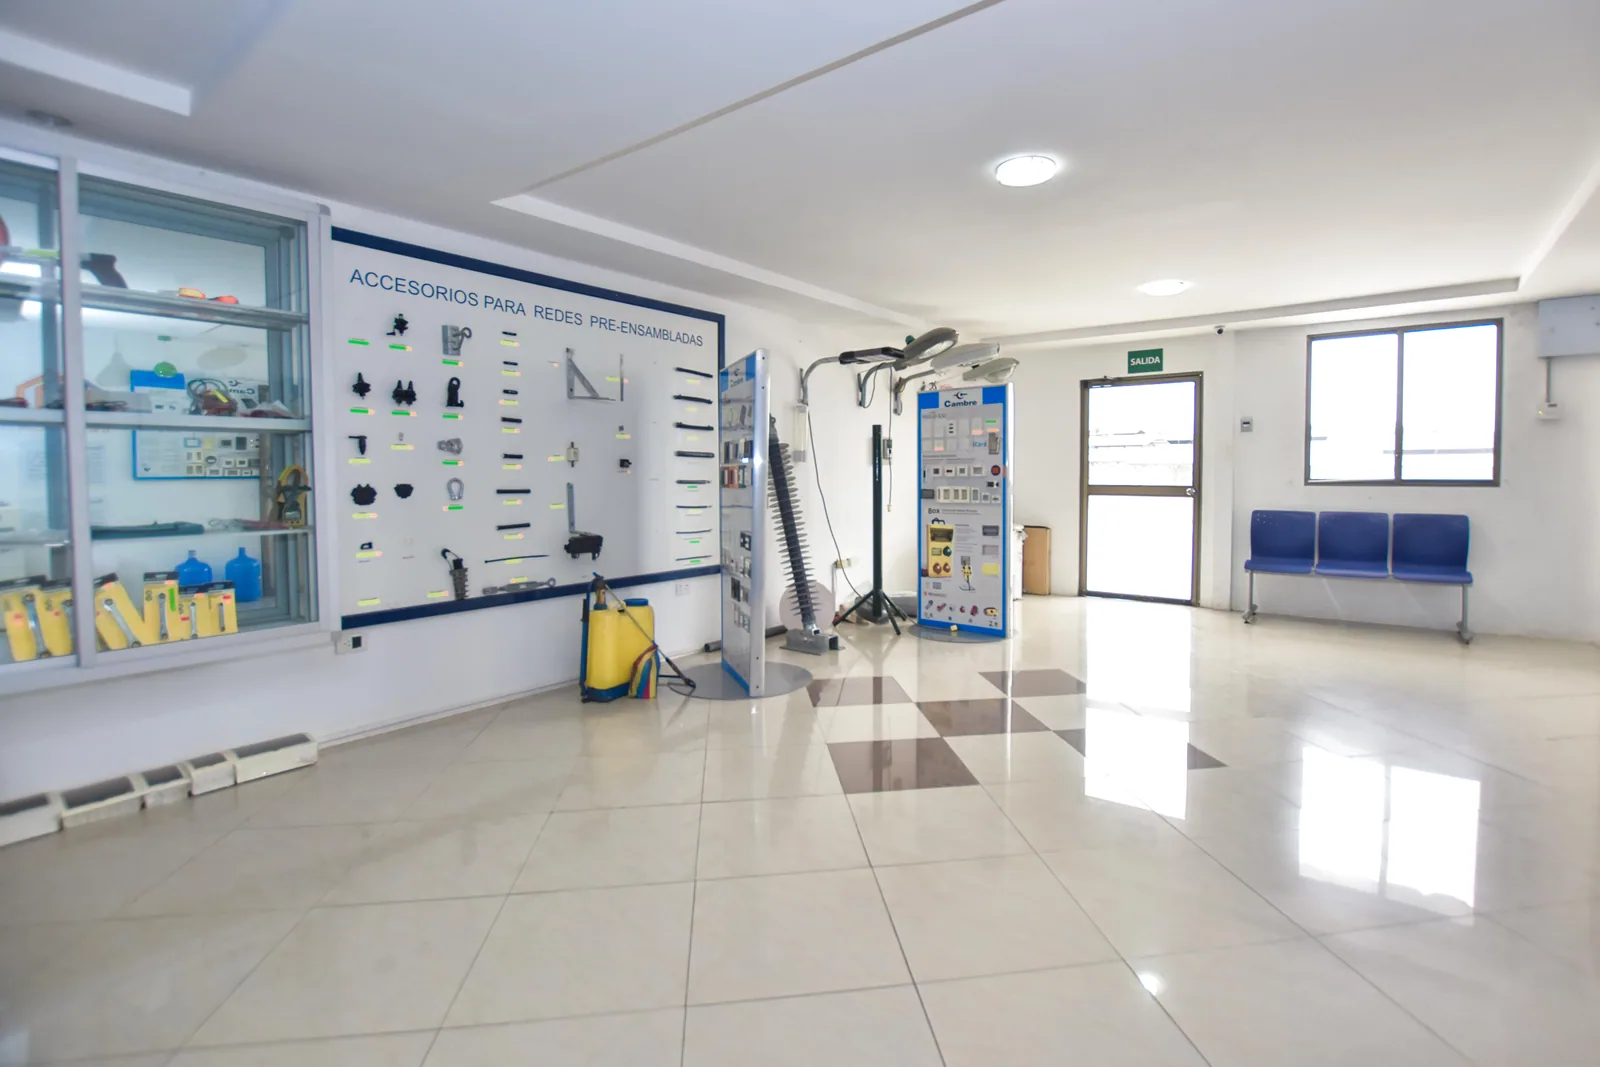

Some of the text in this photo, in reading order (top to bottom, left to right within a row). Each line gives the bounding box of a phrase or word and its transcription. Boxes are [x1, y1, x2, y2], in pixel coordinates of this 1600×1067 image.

[349, 268, 704, 348] ACCESORIOS PARA REDES PRE-ENSAMBLADAS
[1130, 356, 1161, 366] SALIDA
[944, 399, 978, 408] Cambre
[927, 507, 941, 515] Box
